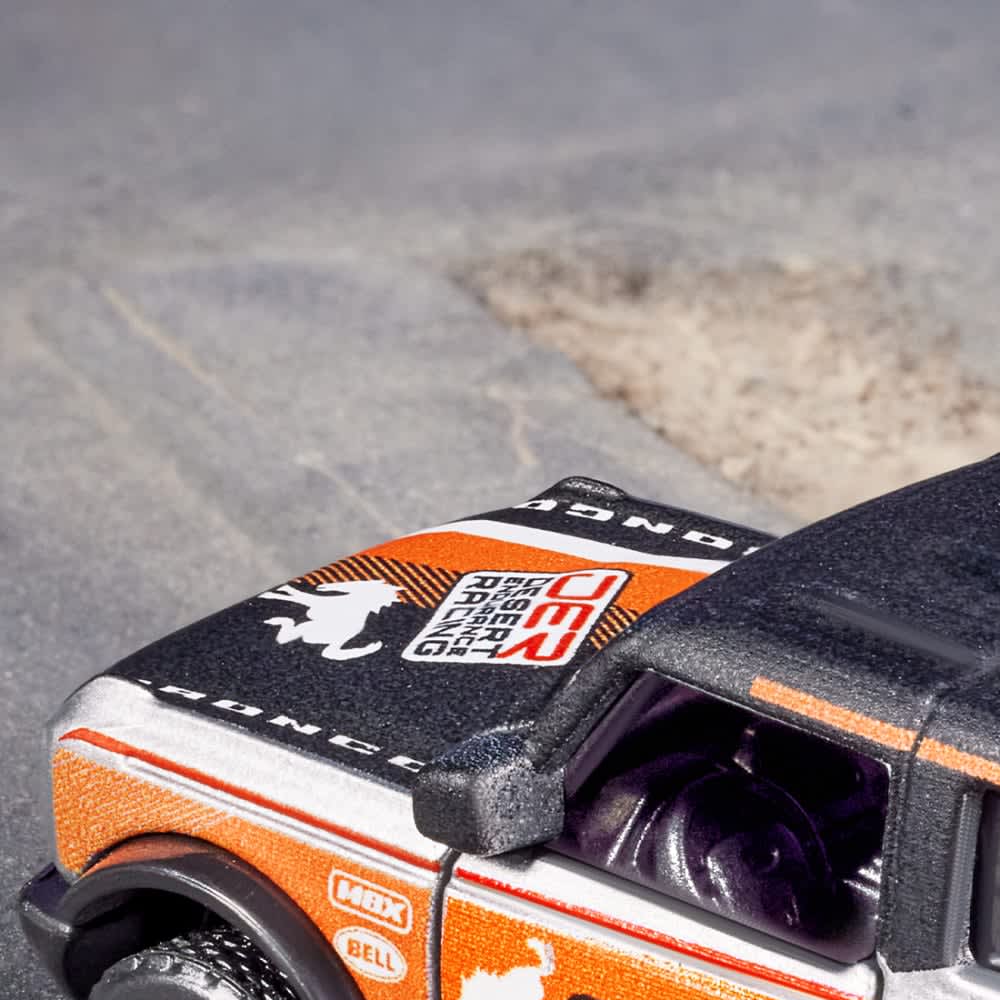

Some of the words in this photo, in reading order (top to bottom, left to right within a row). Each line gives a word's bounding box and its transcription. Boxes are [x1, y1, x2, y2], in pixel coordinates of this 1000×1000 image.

[512, 499, 761, 557] ONCO
[413, 576, 503, 656] RACING
[471, 576, 554, 659] DESERT
[138, 679, 426, 773] RONCO
[347, 938, 396, 973] BELL
